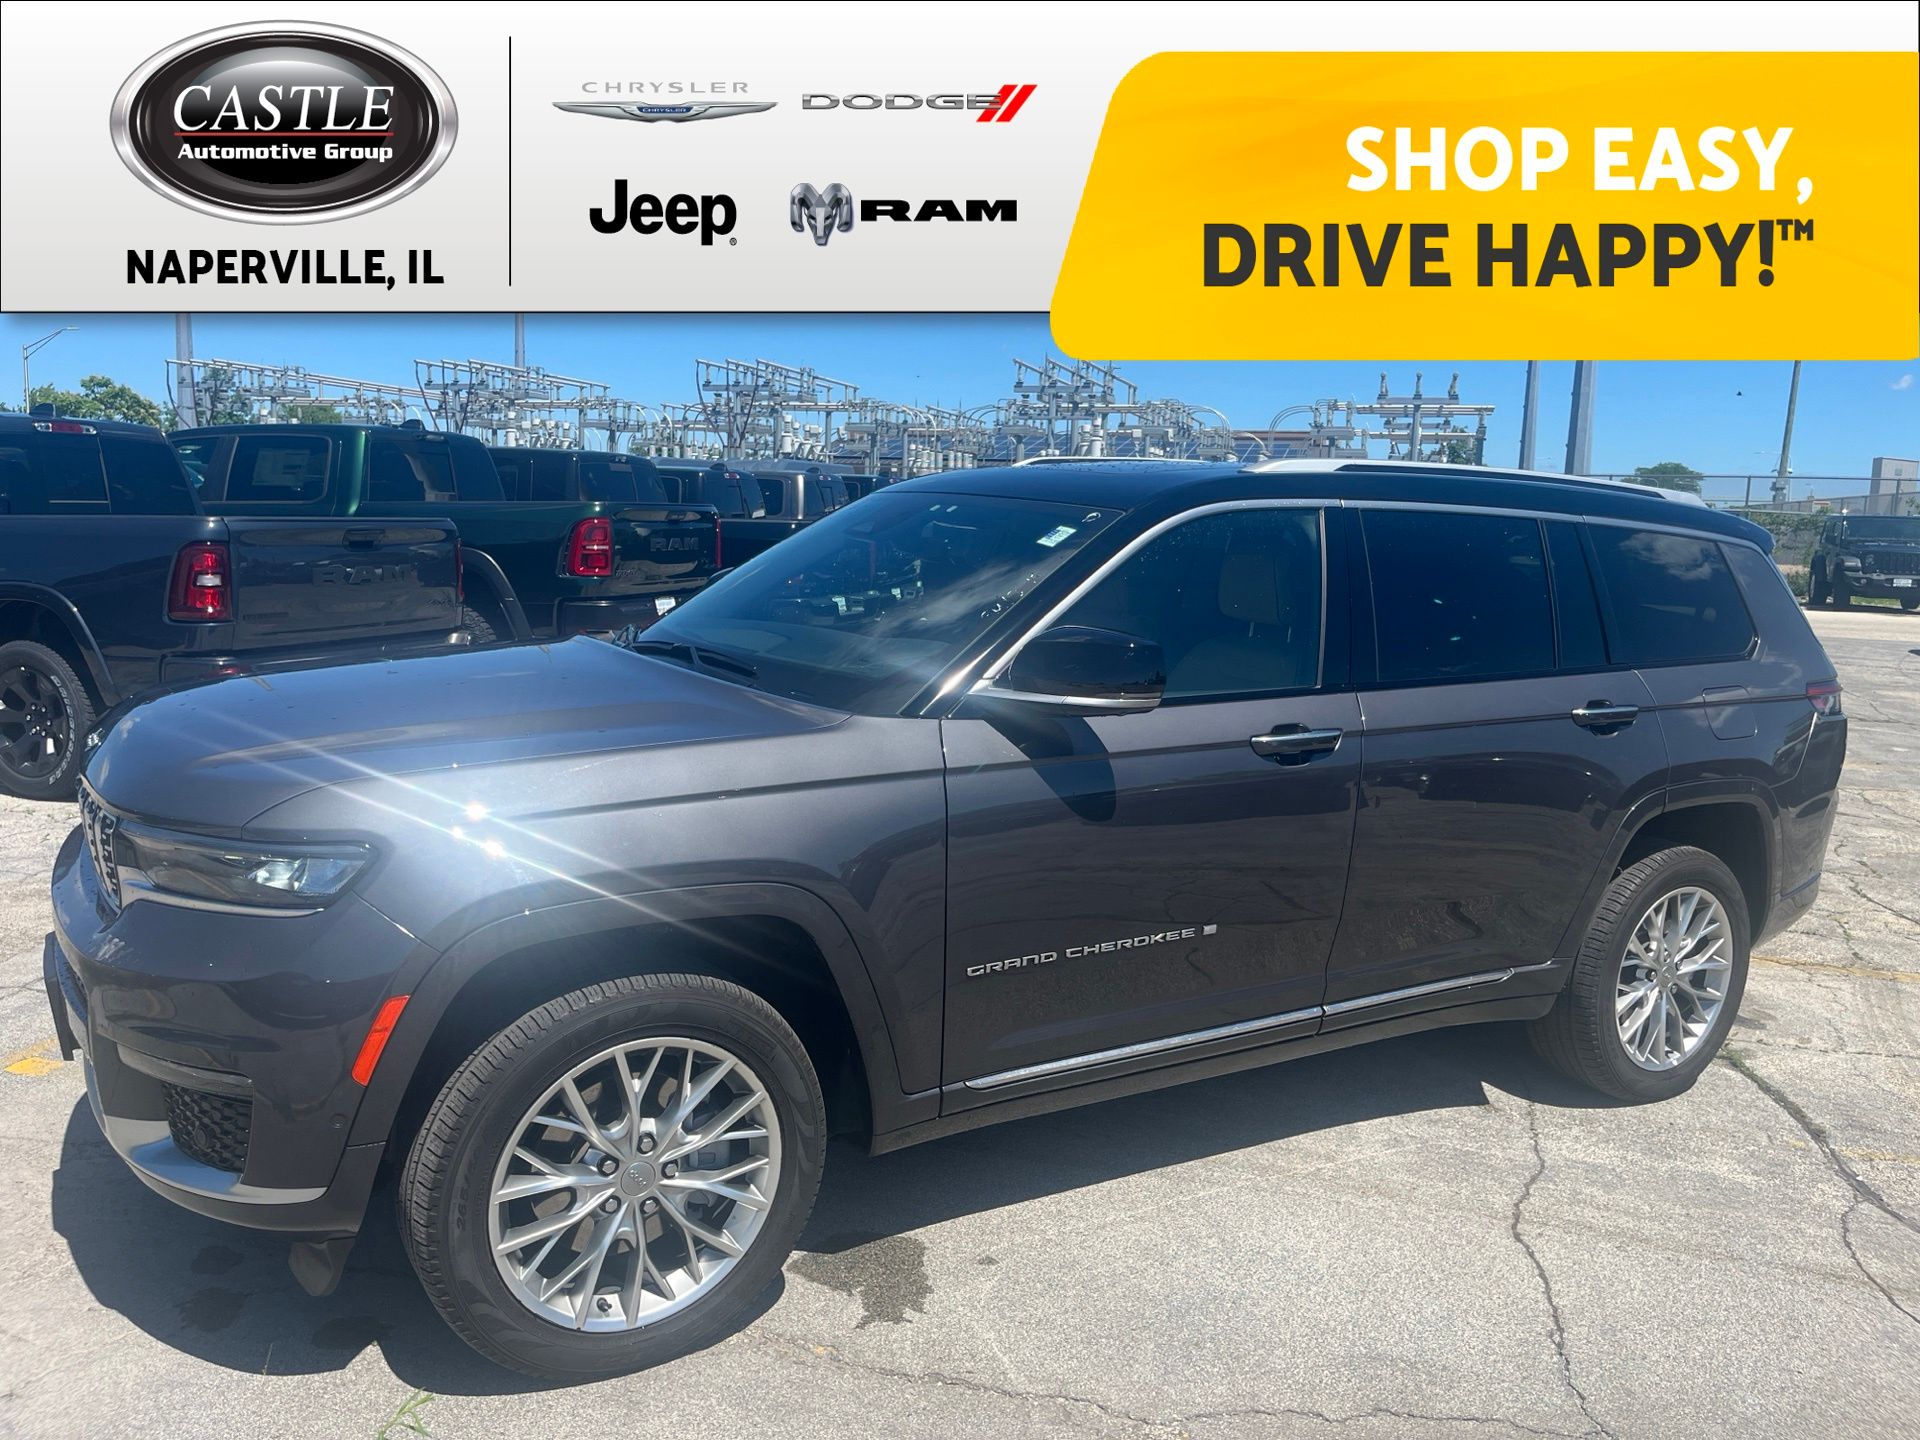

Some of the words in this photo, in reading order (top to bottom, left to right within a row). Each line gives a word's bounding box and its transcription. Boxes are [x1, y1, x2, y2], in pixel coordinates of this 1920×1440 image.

[651, 537, 699, 551] RAM
[966, 951, 1058, 977] GRAND
[1065, 927, 1196, 959] CHEROKEE
